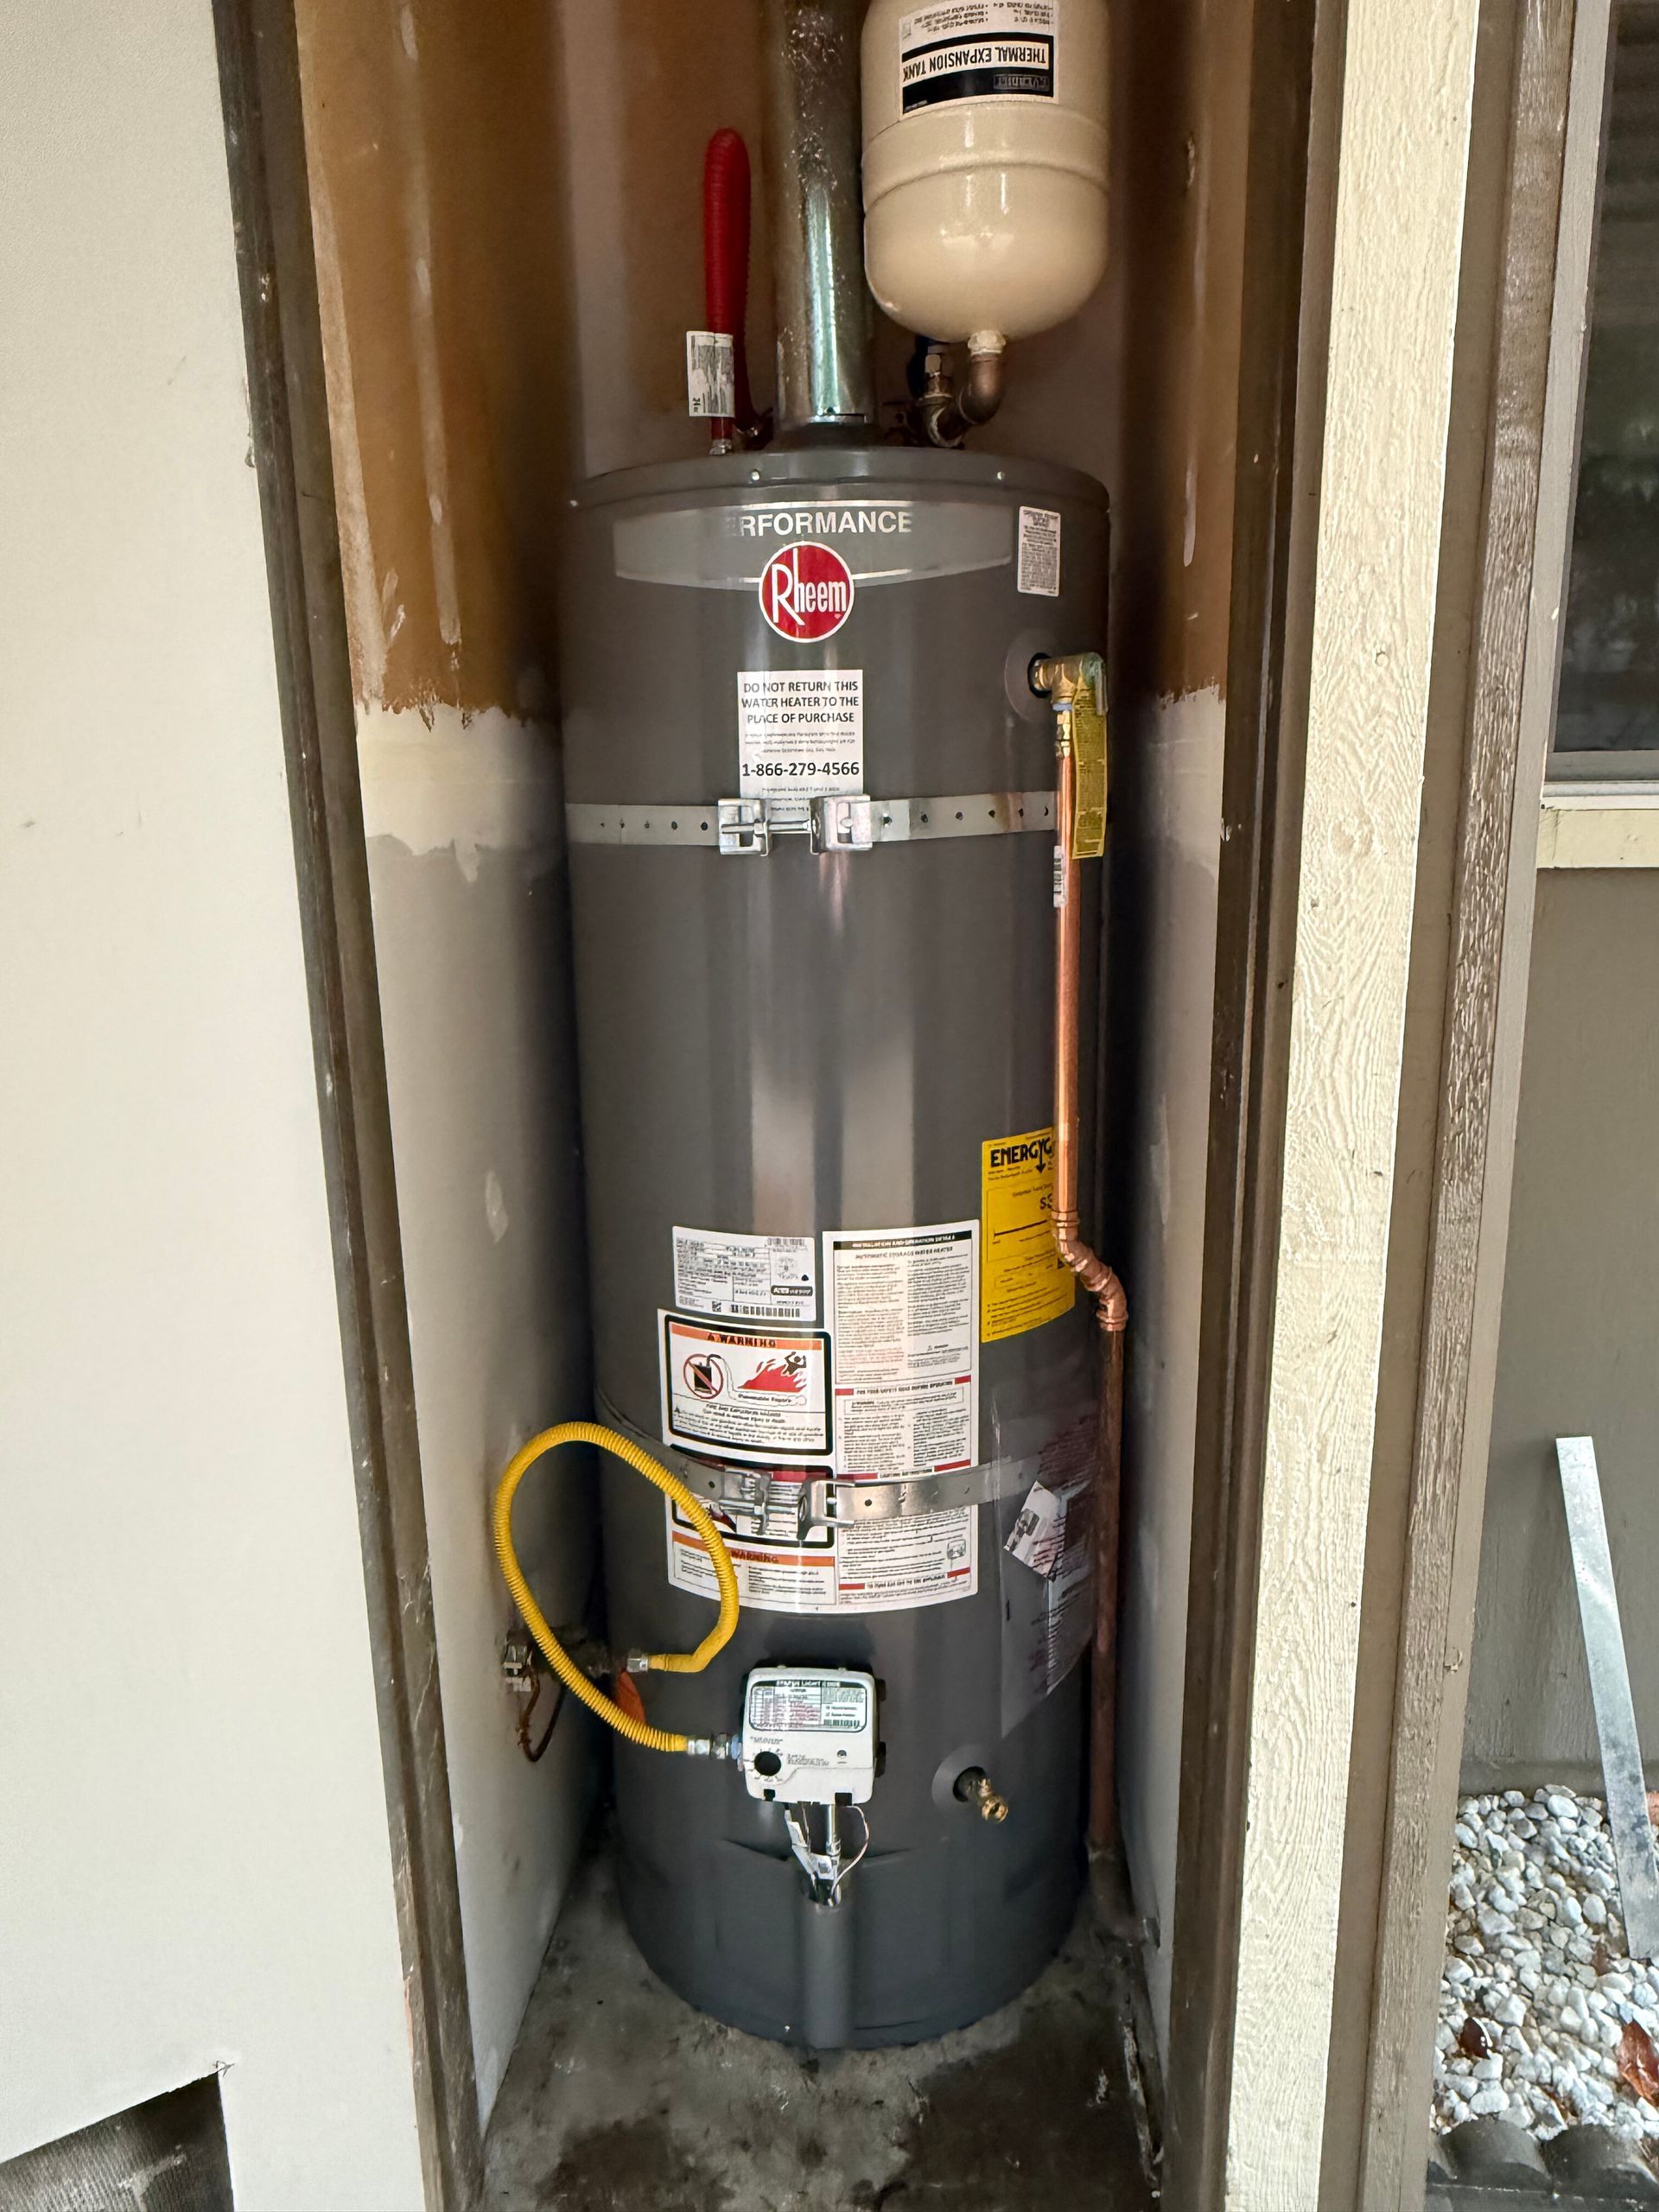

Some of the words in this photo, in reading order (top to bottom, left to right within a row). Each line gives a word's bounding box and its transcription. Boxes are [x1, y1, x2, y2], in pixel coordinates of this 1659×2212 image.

[929, 48, 992, 73] EXPANSION
[995, 46, 1046, 64] THERMAL
[903, 61, 927, 82] TANK
[772, 548, 847, 626] Rheem
[743, 682, 760, 693] DO
[763, 682, 785, 693] NOT
[788, 681, 831, 692] RETURN
[834, 681, 859, 691] THIS
[741, 697, 779, 709] WATER
[780, 696, 821, 708] HEATER
[822, 697, 837, 708] TO
[839, 696, 859, 707] THE
[747, 714, 779, 724] PLACE
[781, 713, 798, 723] OF
[798, 712, 855, 723] PURCHASE
[741, 761, 860, 777] 1-866-279-4566
[720, 1333, 777, 1348] WARNING
